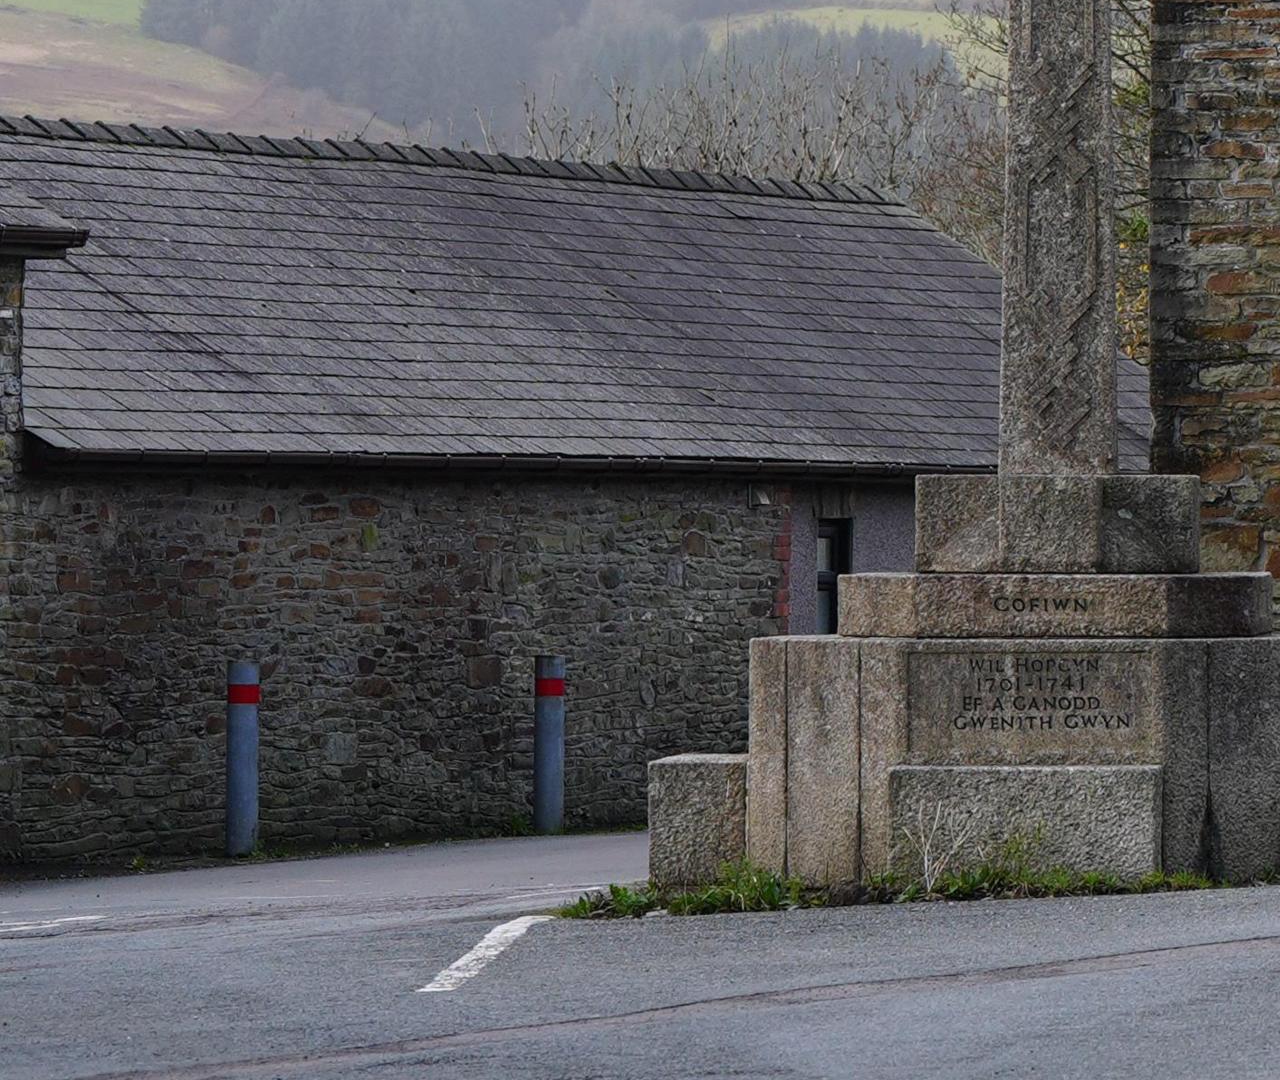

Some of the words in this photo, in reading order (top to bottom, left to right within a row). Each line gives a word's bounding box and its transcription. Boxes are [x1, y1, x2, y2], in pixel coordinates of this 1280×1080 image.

[993, 596, 1089, 612] COFIWN
[969, 658, 1005, 673] WIL
[1015, 658, 1100, 673] HOPCYN
[976, 677, 1086, 693] 1701-1741
[962, 696, 983, 711] EF
[992, 697, 1005, 711] A
[953, 715, 1053, 730] GWENITH
[1064, 714, 1131, 729] GWYN
